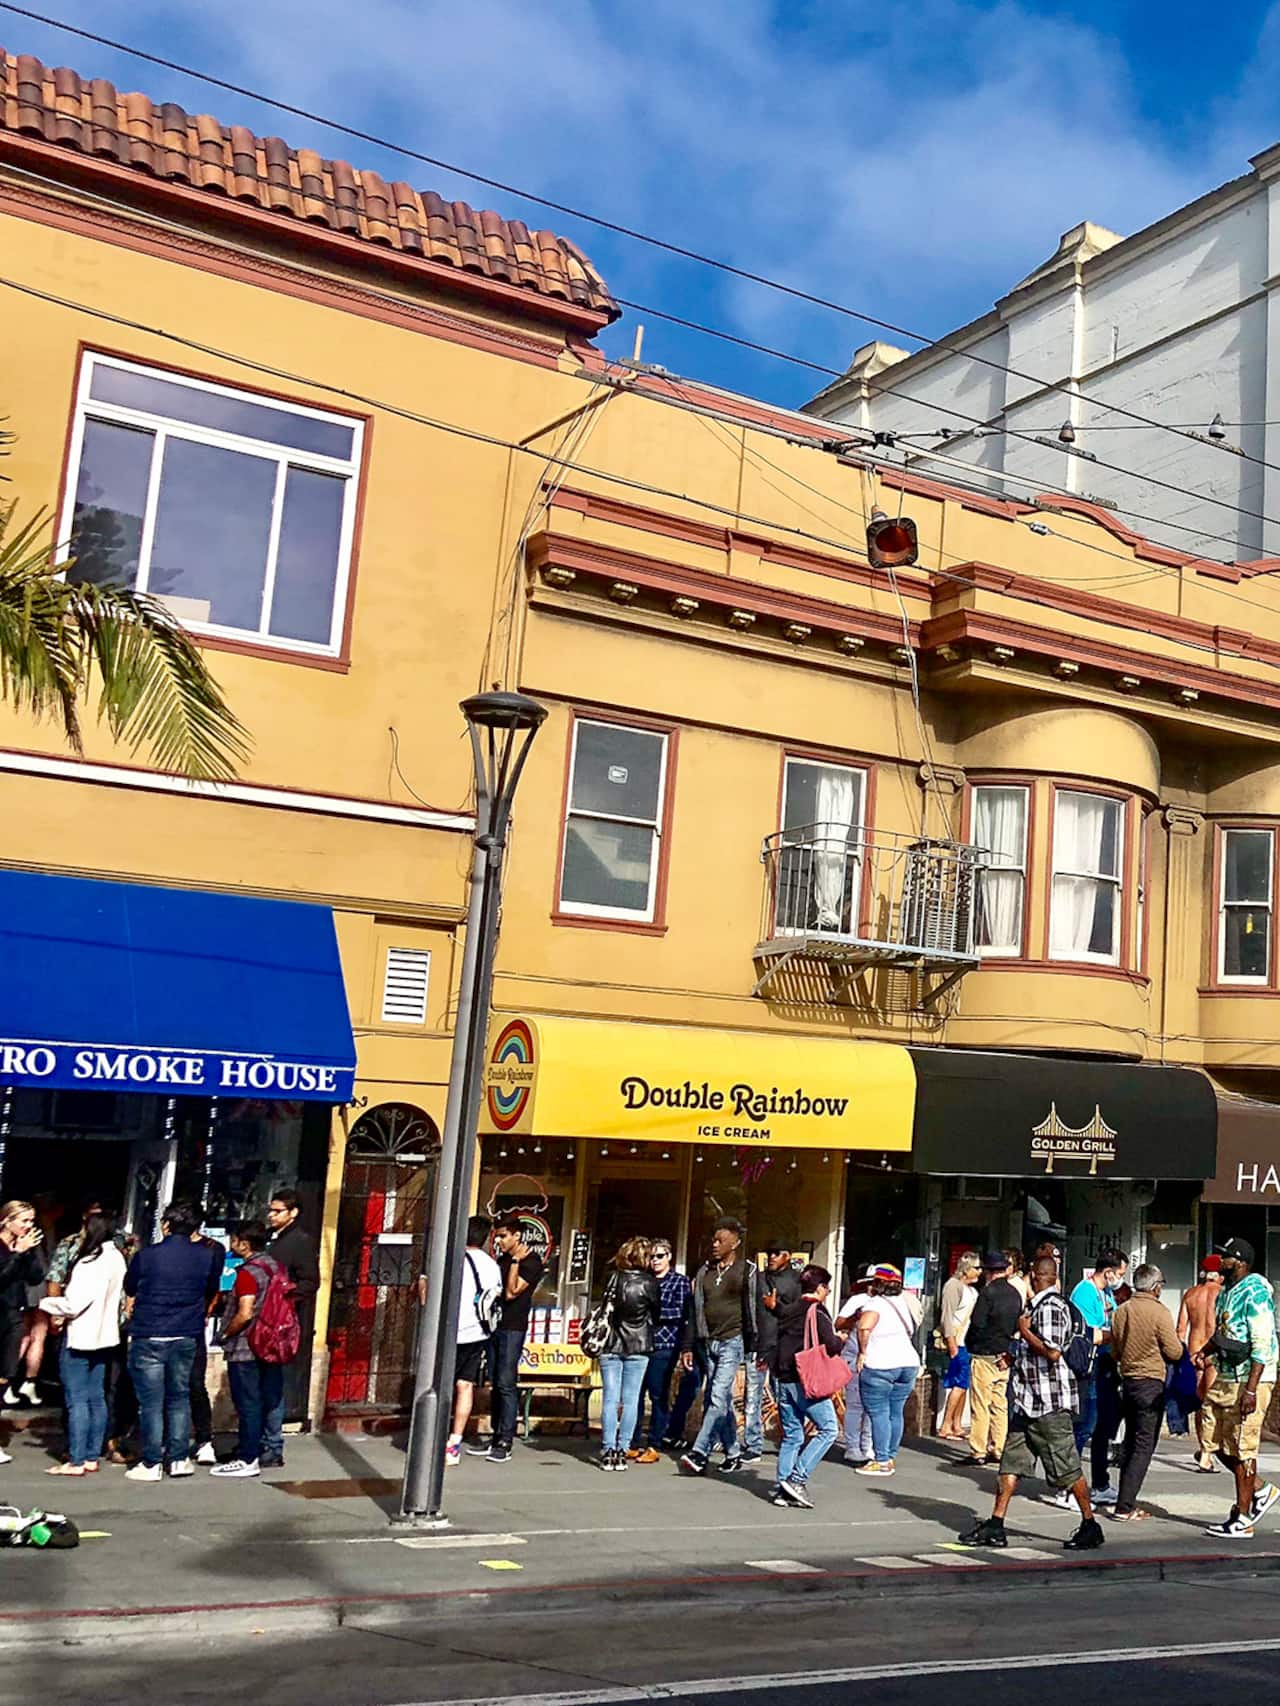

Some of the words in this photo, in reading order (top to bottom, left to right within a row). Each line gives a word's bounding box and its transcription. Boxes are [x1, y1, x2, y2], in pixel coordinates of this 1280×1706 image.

[0, 1045, 56, 1076] RO
[73, 1050, 205, 1085] SMOKE
[219, 1059, 337, 1092] HOUSE
[620, 1076, 724, 1110] Double
[729, 1084, 848, 1122] Rainbow
[698, 1126, 720, 1137] ICE
[723, 1127, 771, 1139] CREAM
[1032, 1137, 1080, 1151] GOLDEN
[1081, 1139, 1116, 1152] GRILL
[519, 1347, 587, 1369] Rainbow
